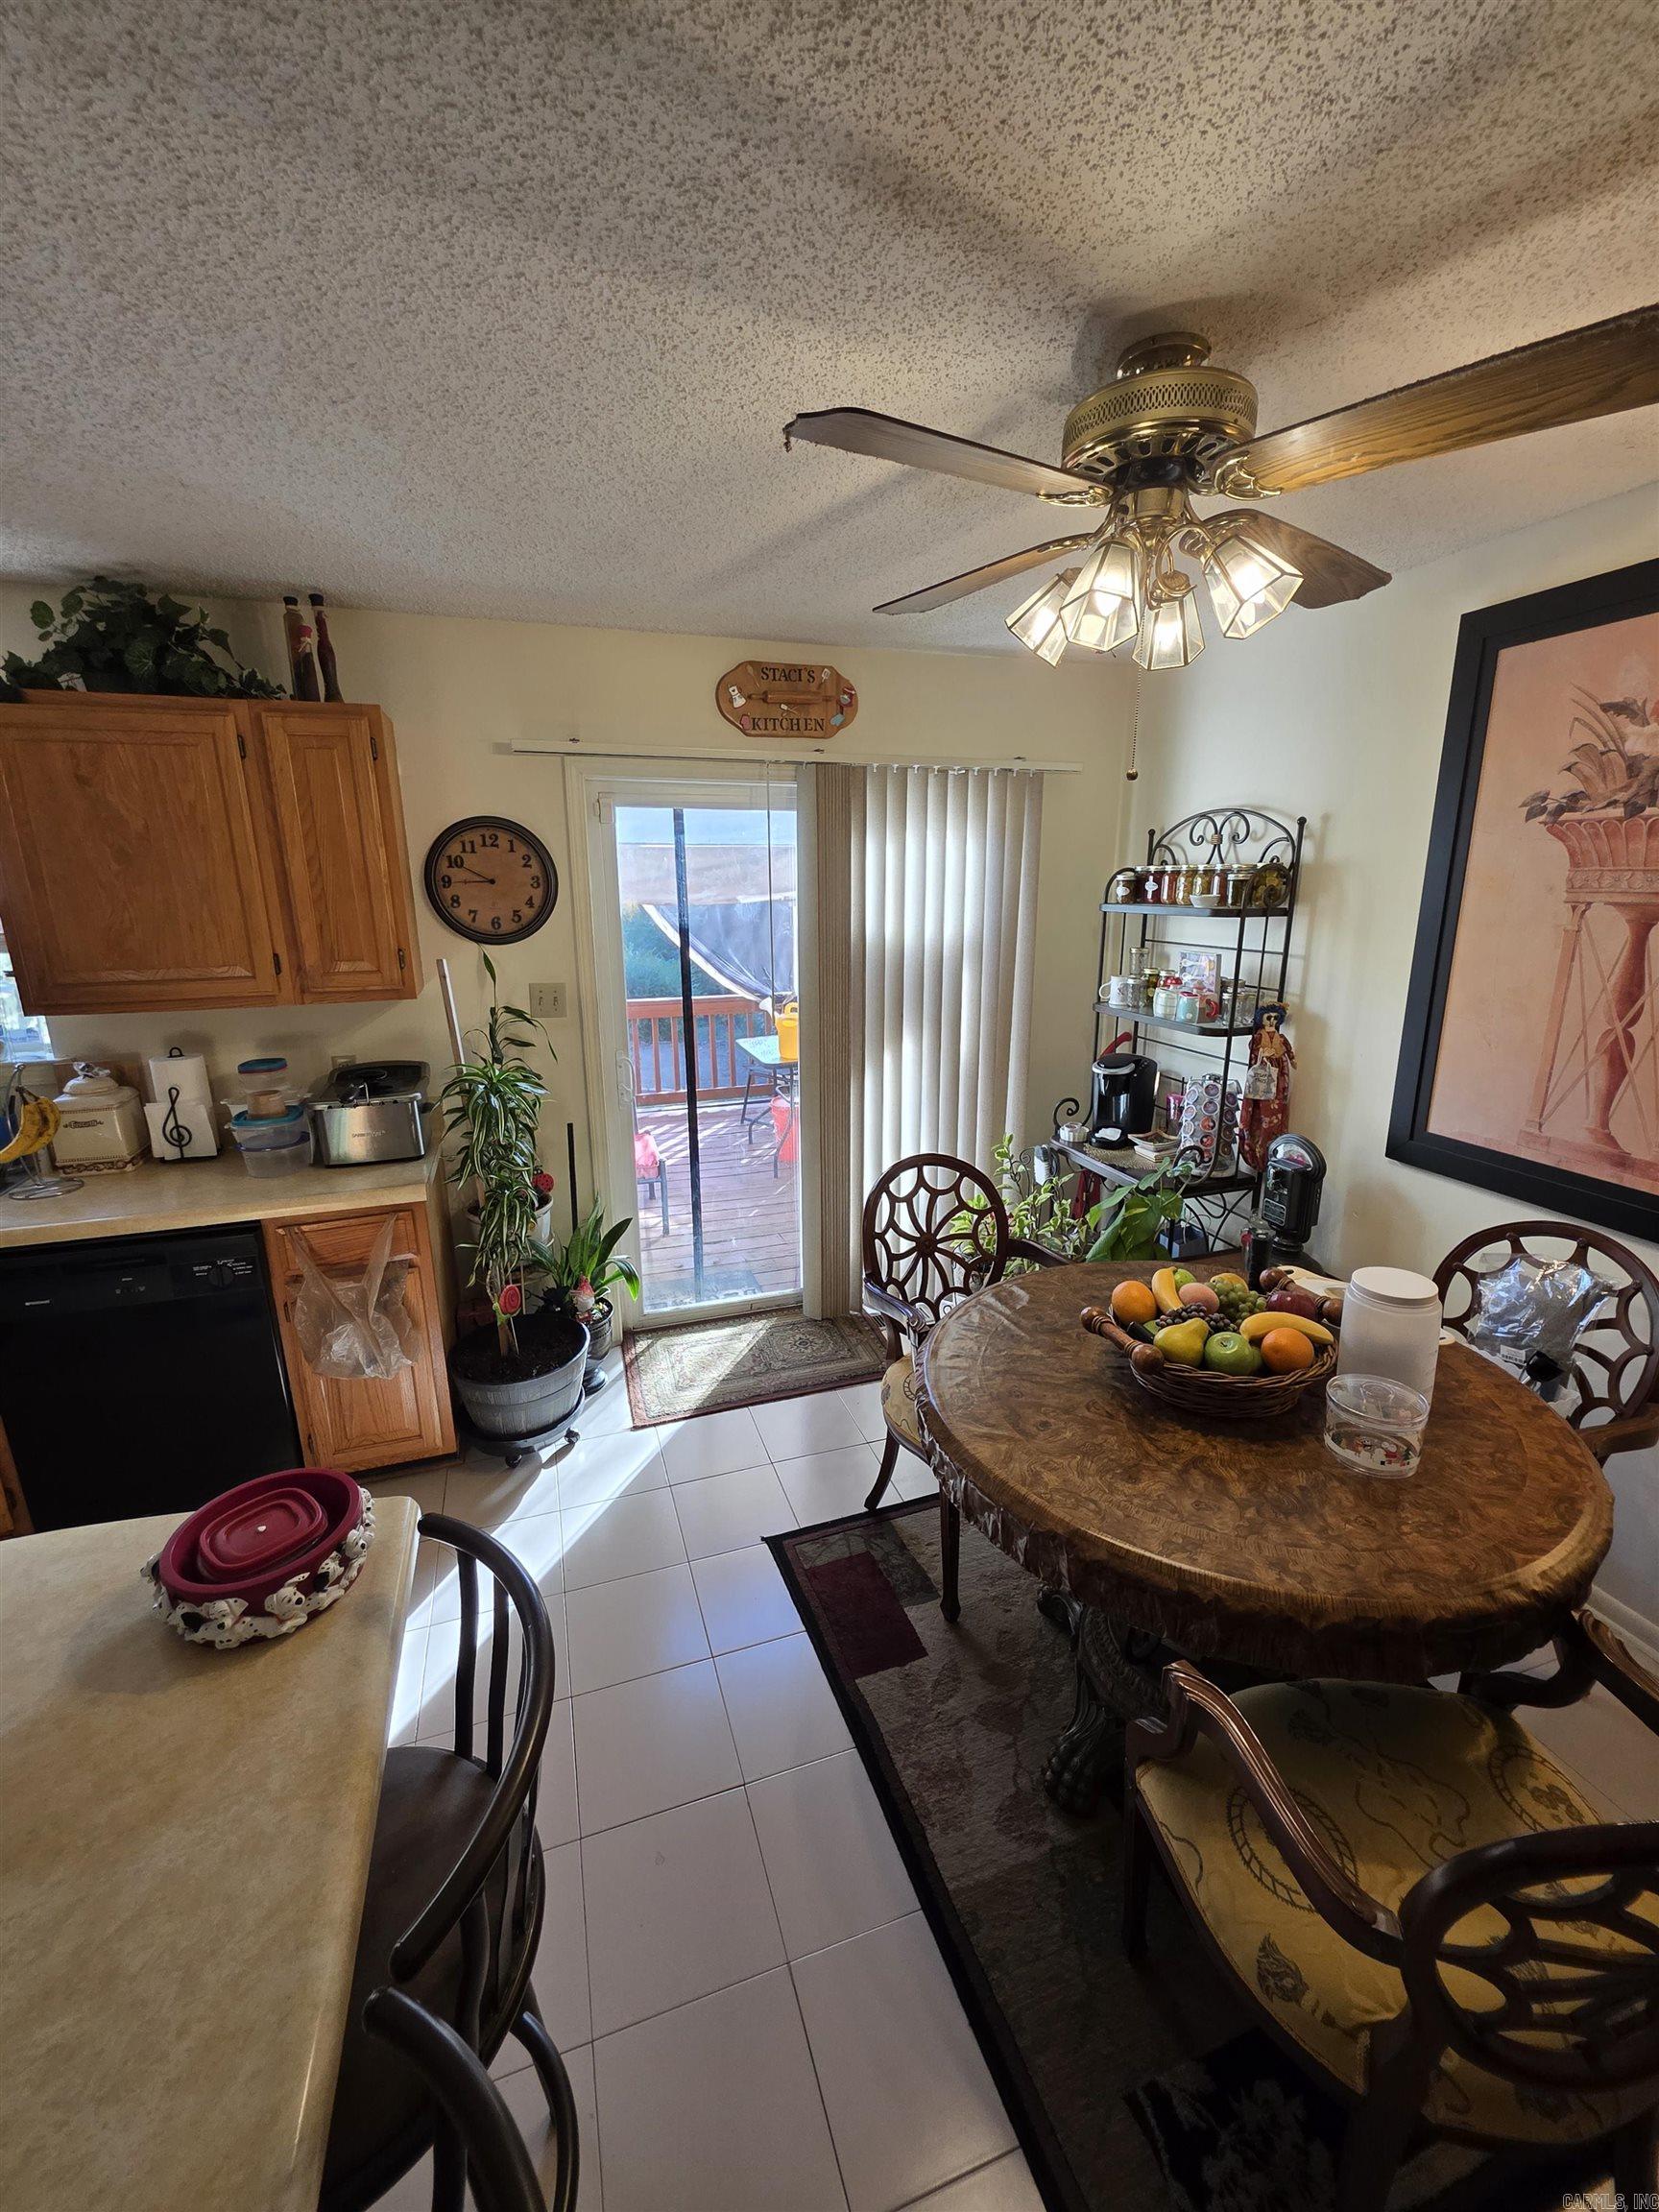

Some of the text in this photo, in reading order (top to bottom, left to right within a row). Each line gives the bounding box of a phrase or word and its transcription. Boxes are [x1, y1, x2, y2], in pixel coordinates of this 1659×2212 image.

[760, 665, 816, 684] STACI'S
[751, 717, 825, 732] KITCHEN
[459, 840, 477, 854] 11
[480, 833, 499, 849] 12
[507, 839, 517, 854] 1
[445, 854, 465, 869] 10
[521, 854, 532, 869] 2
[441, 875, 452, 889] 9
[530, 876, 541, 889] 3
[450, 894, 461, 908] 8
[525, 896, 535, 908] 4
[469, 909, 478, 923] 7
[512, 909, 522, 923] 5
[491, 917, 502, 930] 6
